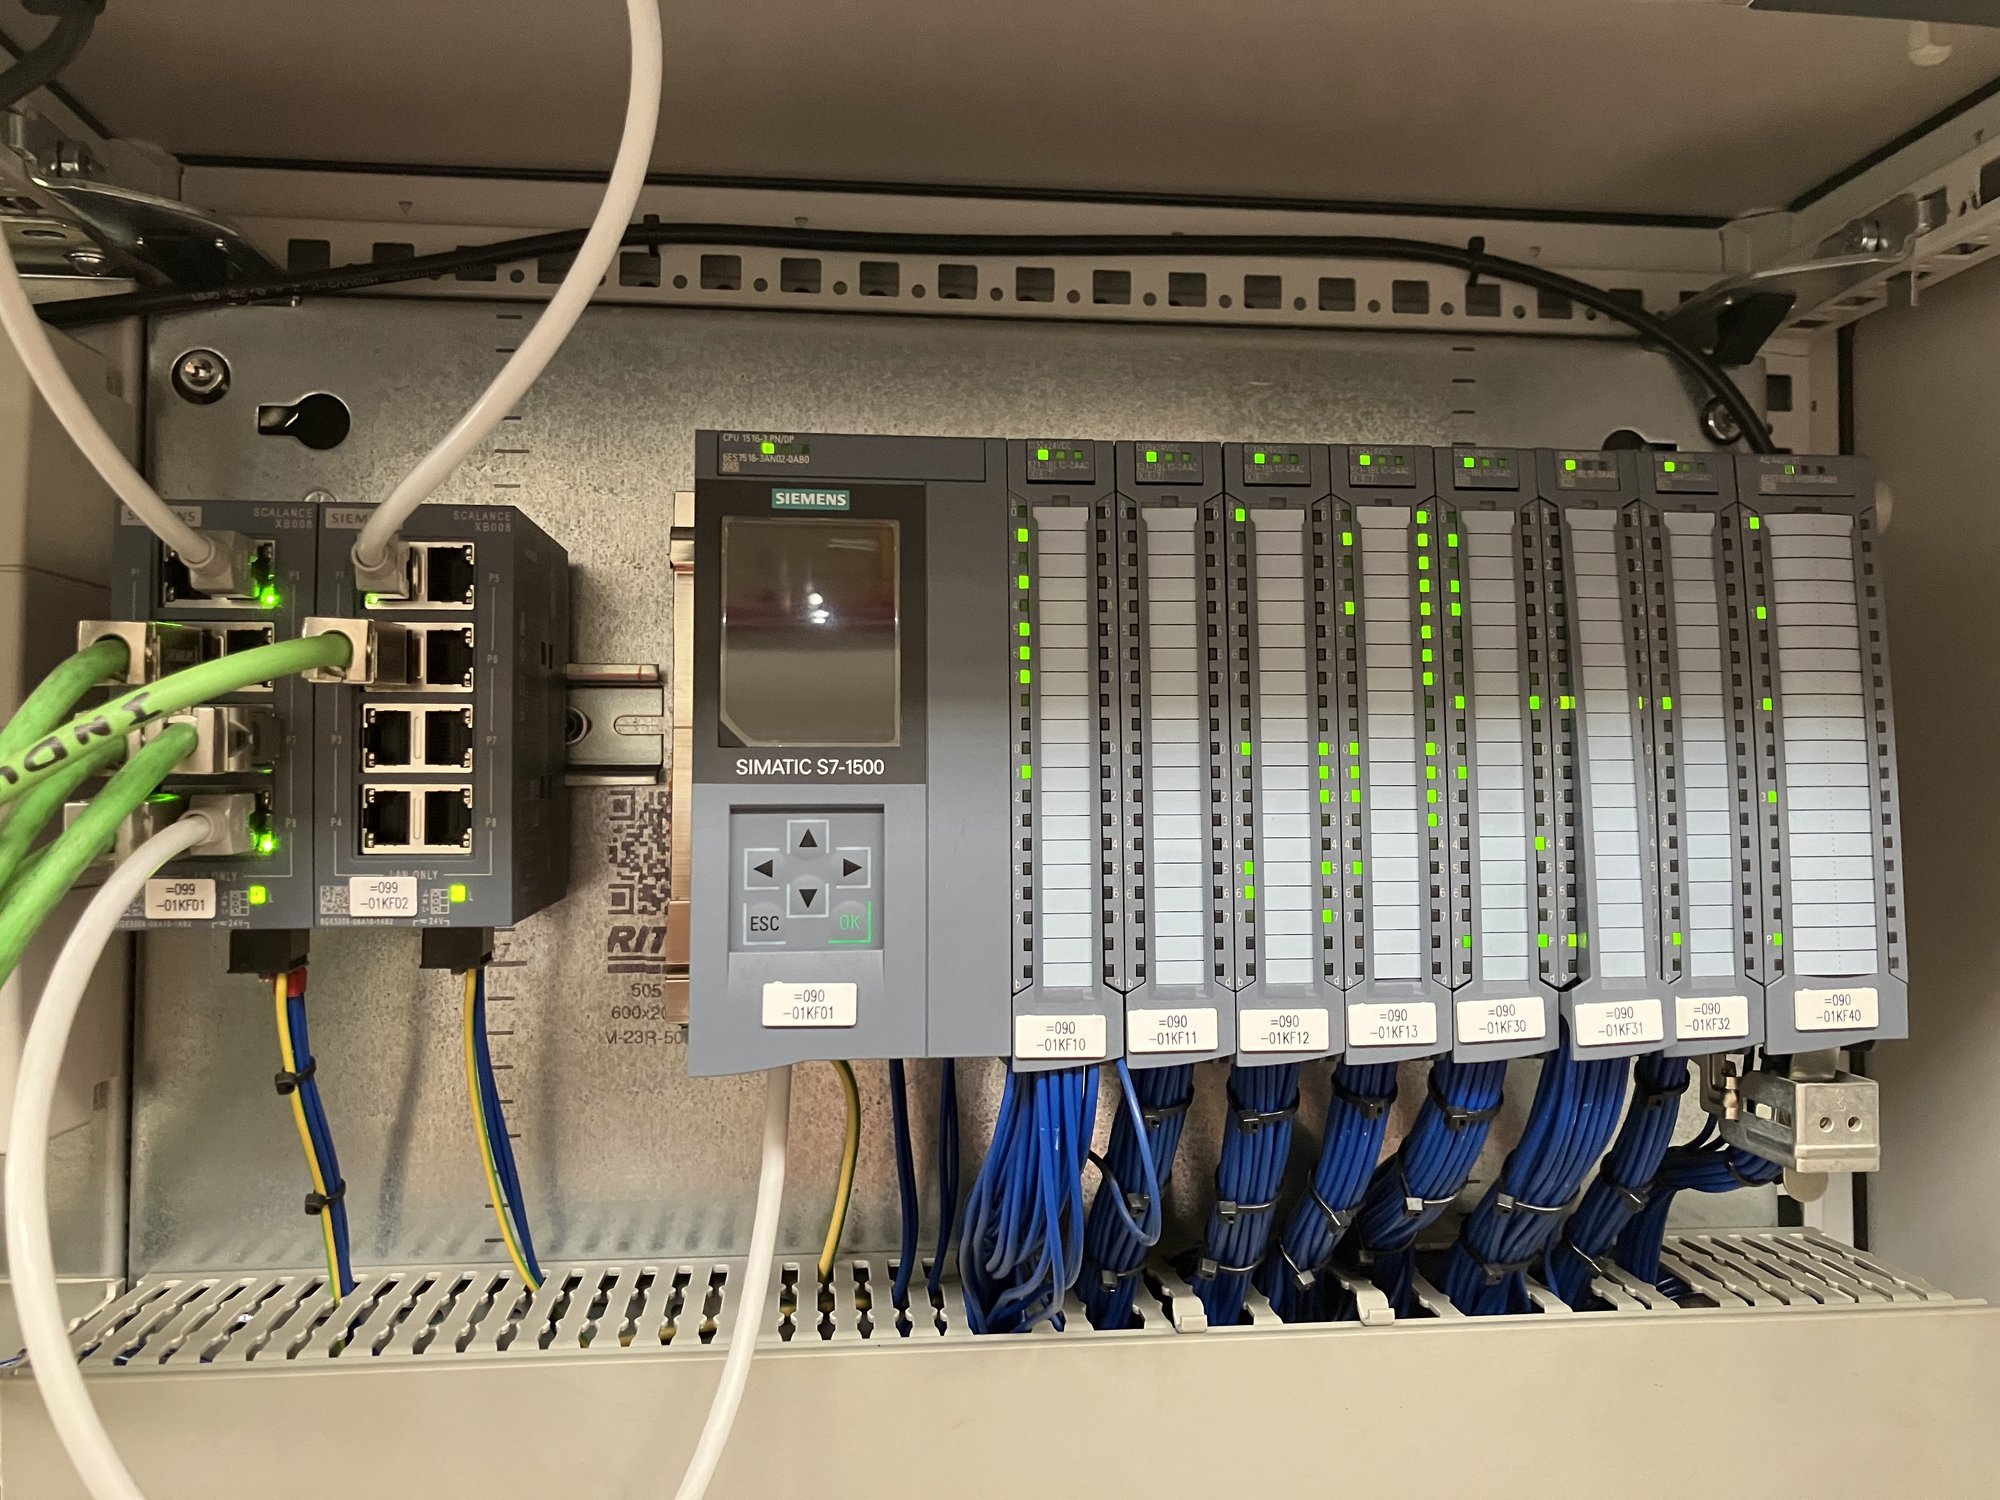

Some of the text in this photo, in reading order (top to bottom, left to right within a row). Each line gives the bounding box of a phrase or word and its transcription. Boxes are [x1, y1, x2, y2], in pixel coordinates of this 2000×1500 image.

[722, 433, 740, 443] CPU
[775, 491, 847, 507] SIEMENS
[252, 507, 313, 519] SCALANCE
[331, 513, 367, 524] SIEM
[453, 510, 512, 522] SCALANCE
[274, 518, 313, 529] XB008
[474, 521, 512, 532] XB008
[735, 758, 885, 777] SIMATIC S7-1500
[165, 883, 196, 895] =099
[369, 881, 399, 894] =099
[156, 899, 206, 912] -01KF01
[359, 897, 409, 910] -01KF02
[750, 915, 780, 932] ESC
[839, 914, 861, 931] OK
[607, 925, 666, 954] RIT
[793, 989, 826, 1004] =090
[1823, 994, 1852, 1007] =090
[783, 1005, 835, 1021] -01KF01
[1487, 1004, 1517, 1018] =090
[1605, 1006, 1635, 1020] =090
[1692, 1002, 1722, 1015] =090
[1815, 1008, 1863, 1023] -01KF40
[1158, 1015, 1189, 1029] =090
[1269, 1015, 1300, 1028] =090
[1379, 1009, 1409, 1023] =090
[1045, 1021, 1076, 1035] =090
[1478, 1019, 1528, 1034] -01KF30
[1597, 1021, 1645, 1037] -01KF31
[1684, 1016, 1731, 1032] -01KF32
[1147, 1031, 1198, 1046] -01KF11
[1260, 1030, 1310, 1046] -01KF12
[1369, 1024, 1419, 1039] -01KF13
[1035, 1037, 1087, 1053] -01KF10
